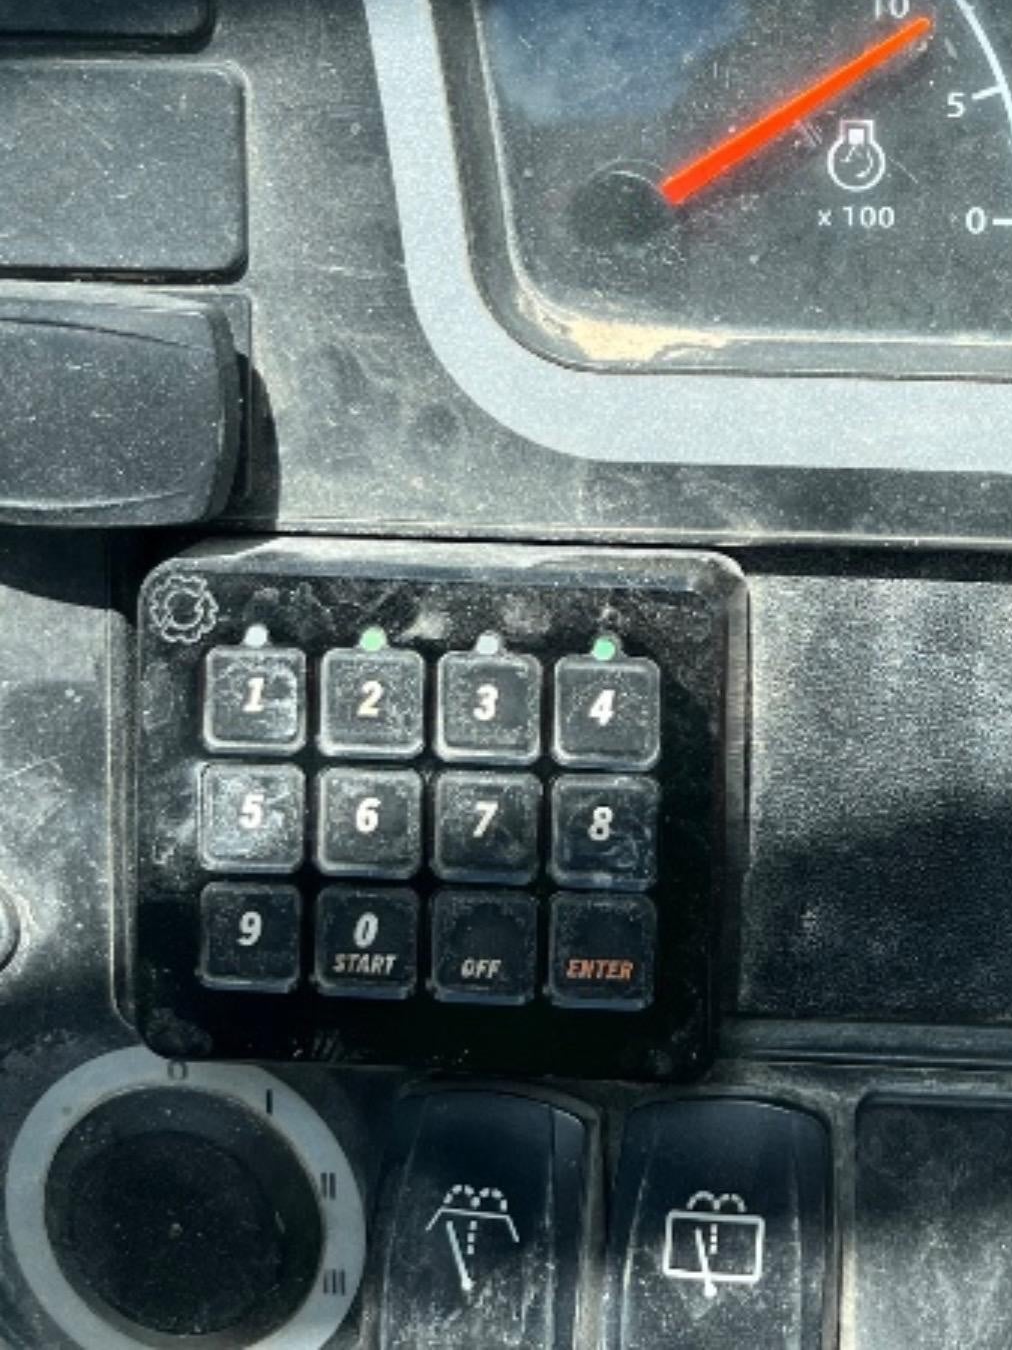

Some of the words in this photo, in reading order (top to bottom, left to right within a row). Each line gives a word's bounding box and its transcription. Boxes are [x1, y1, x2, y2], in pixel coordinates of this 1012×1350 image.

[946, 94, 965, 118] 5
[845, 206, 896, 228] 100
[965, 208, 985, 235] 0
[243, 677, 265, 712] 1
[357, 681, 383, 717] 2
[473, 684, 498, 721] 3
[589, 689, 616, 726] 4
[239, 793, 263, 830] 5
[355, 799, 380, 833] 6
[473, 800, 497, 838] 7
[588, 805, 613, 842] 8
[236, 911, 262, 946] 9
[354, 913, 379, 948] 0
[332, 953, 396, 975] START
[460, 958, 501, 979] OFF
[566, 959, 635, 981] ENTER
